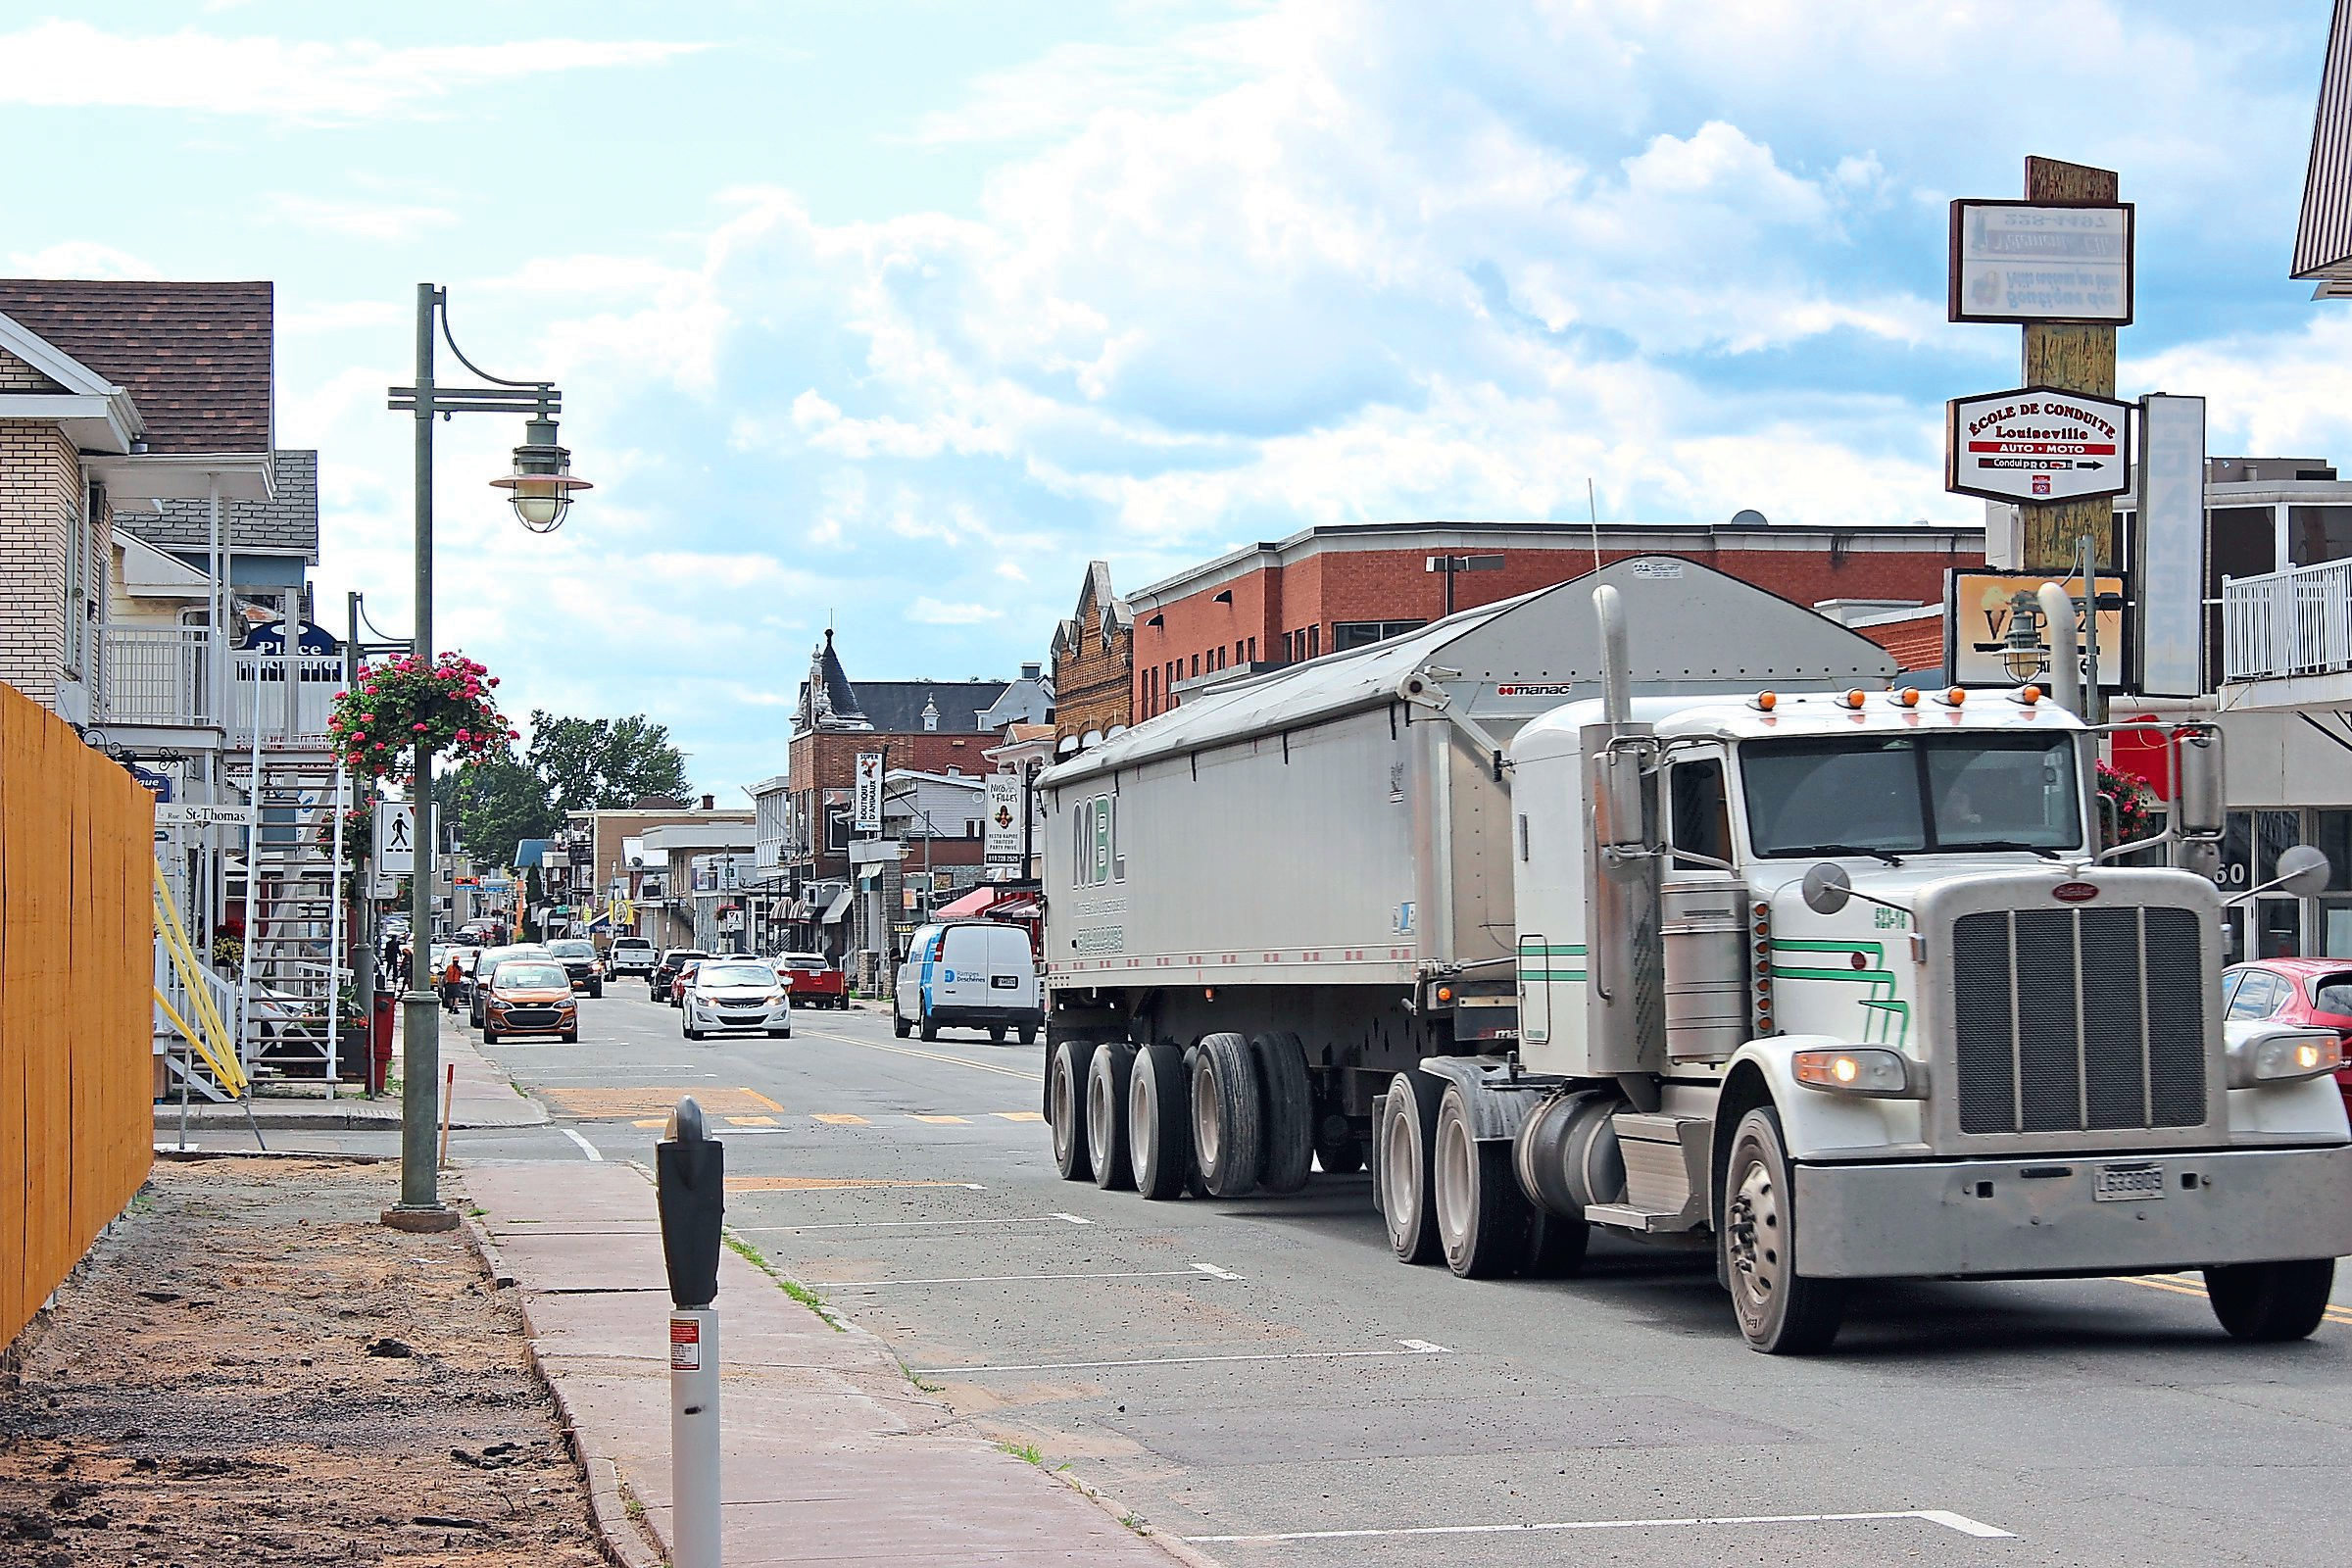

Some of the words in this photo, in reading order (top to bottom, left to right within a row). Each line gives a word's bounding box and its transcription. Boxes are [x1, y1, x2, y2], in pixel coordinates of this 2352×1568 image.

[1968, 406, 2017, 437] ÉCOLE
[2020, 403, 2040, 416] DE
[2043, 403, 2117, 440] CONDUITE
[1995, 425, 2089, 441] Louiseville
[1999, 443, 2034, 453] AUTO
[2046, 445, 2085, 454] MOTO
[258, 641, 322, 656] Plce
[1514, 684, 1570, 695] manac
[996, 793, 1018, 804] FILLES
[185, 808, 246, 821] St-Thomas
[1073, 793, 1126, 891] MBL
